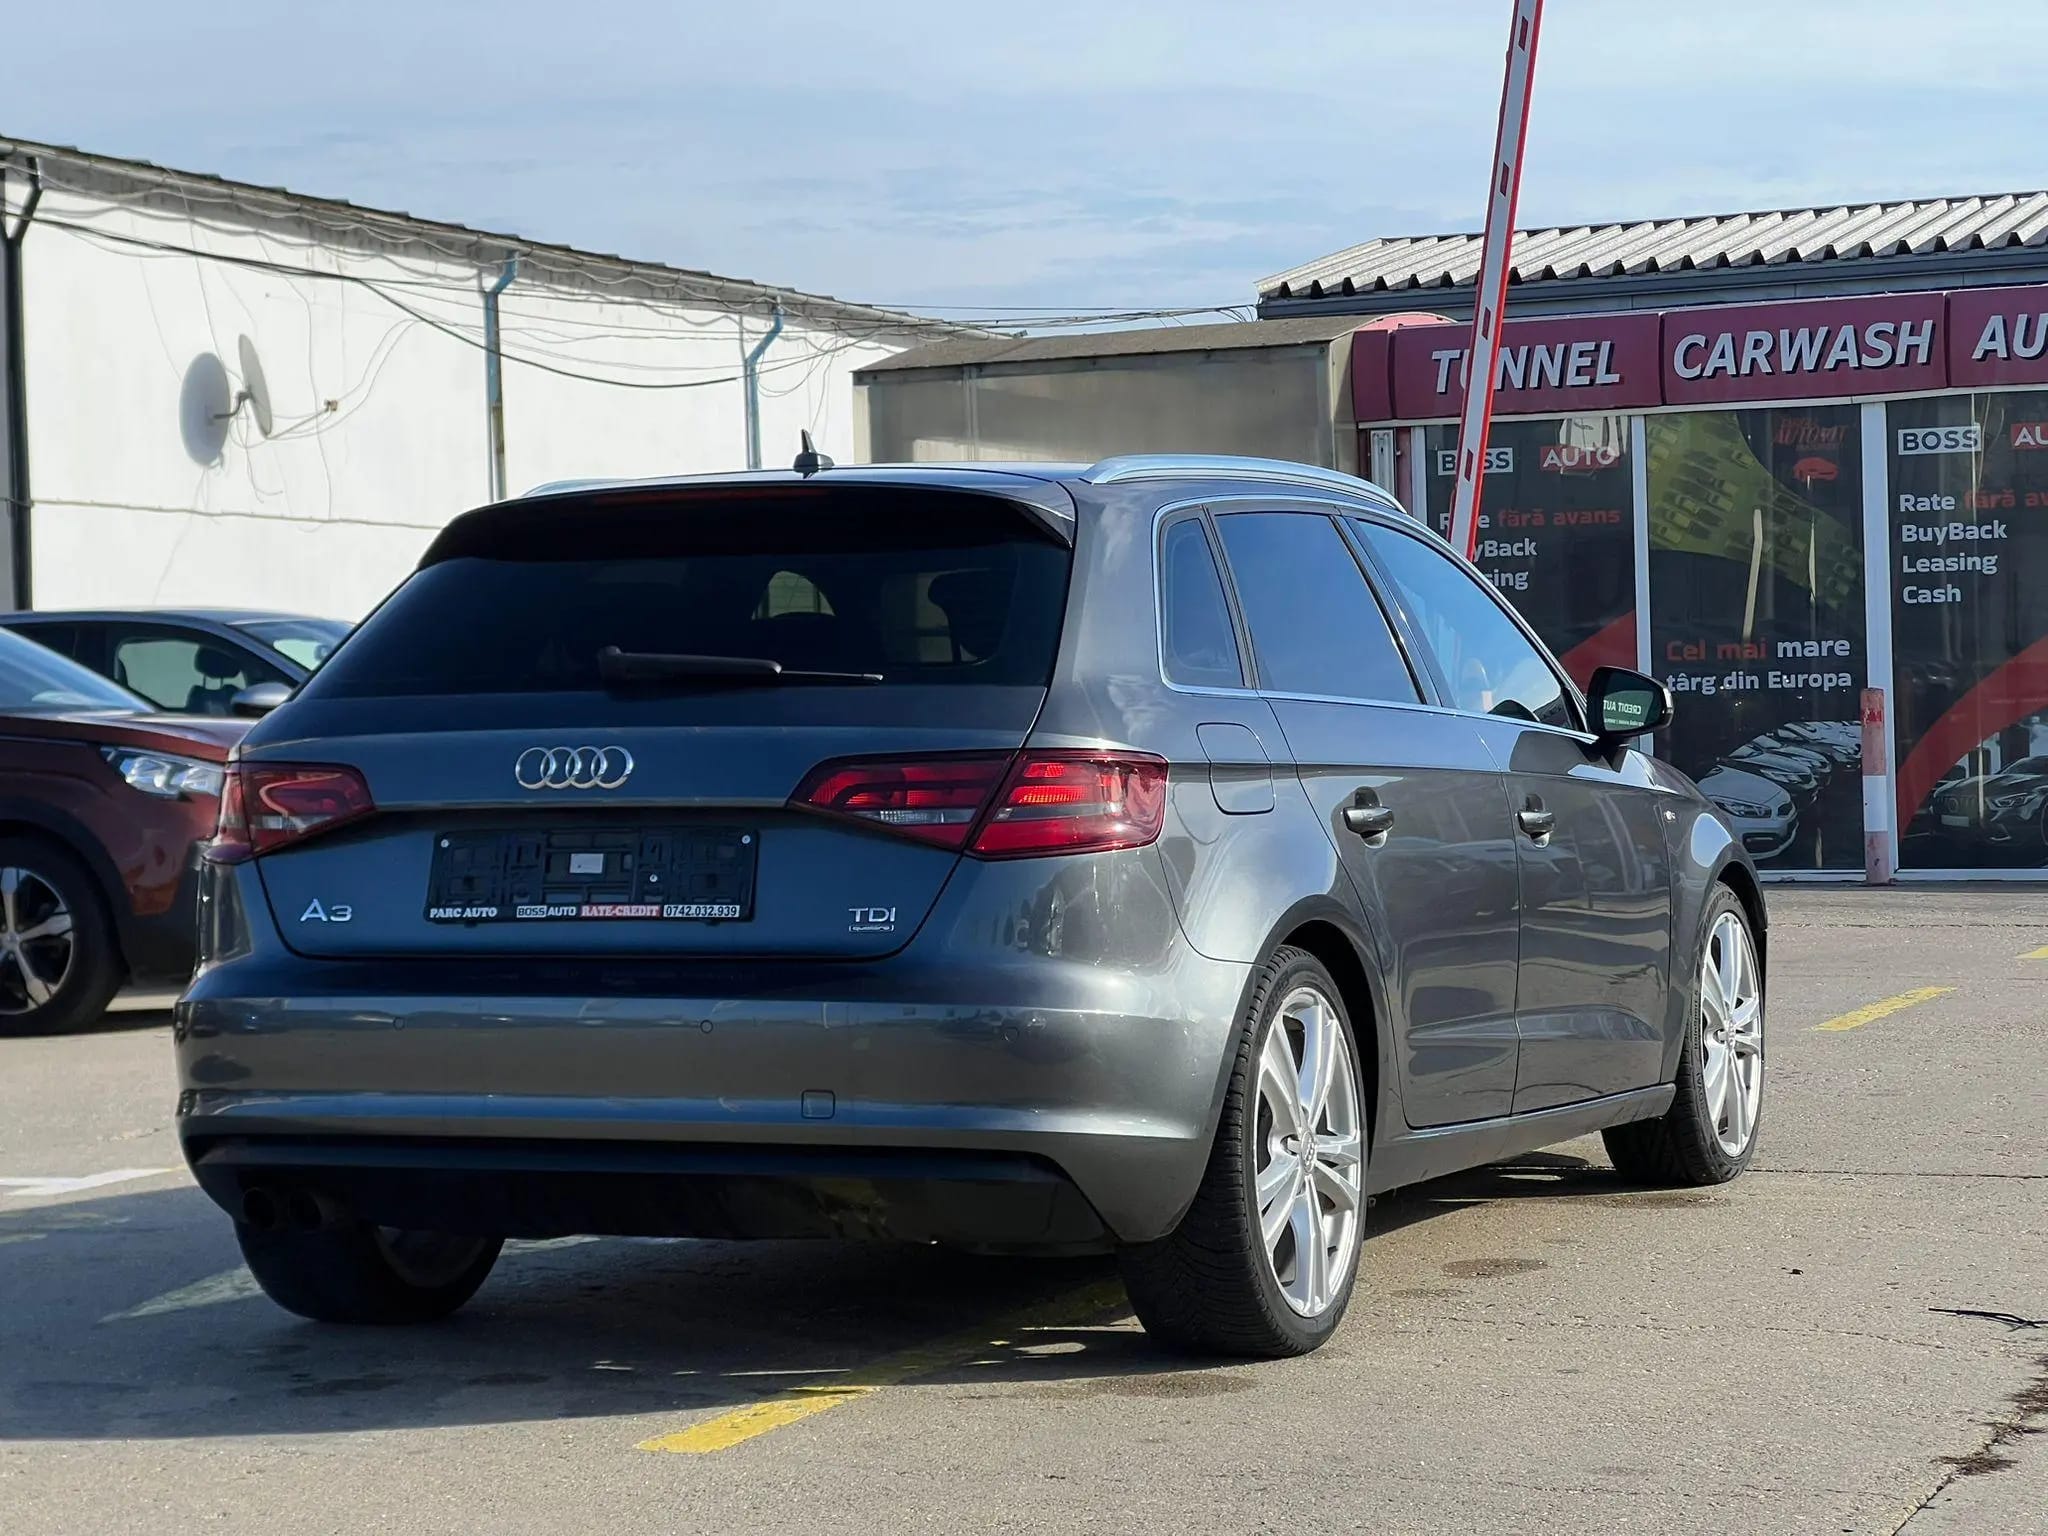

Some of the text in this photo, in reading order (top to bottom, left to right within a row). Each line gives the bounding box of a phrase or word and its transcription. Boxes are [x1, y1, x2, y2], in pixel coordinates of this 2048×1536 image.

[1673, 319, 1934, 379] CARWASH
[1902, 429, 1979, 451] BOSS
[1442, 447, 1616, 472] BSS AUTO
[1899, 493, 1956, 512] Rate
[1439, 513, 1490, 531] Re
[1553, 509, 1622, 526] avans
[1901, 520, 2008, 546] BuyBack
[1473, 537, 1538, 563] yBack
[1902, 552, 1999, 575] Leasing
[1902, 583, 1962, 604] Cash
[1666, 637, 1851, 661] Cel mai mare
[1666, 671, 1852, 695] târg din Europa
[300, 898, 353, 922] A3
[429, 907, 462, 918] PARC
[463, 906, 498, 918] AUTO
[517, 906, 546, 917] BOSS
[546, 906, 577, 916] AUTO
[665, 905, 738, 917] 0742.032.939
[848, 907, 896, 922] TDI
